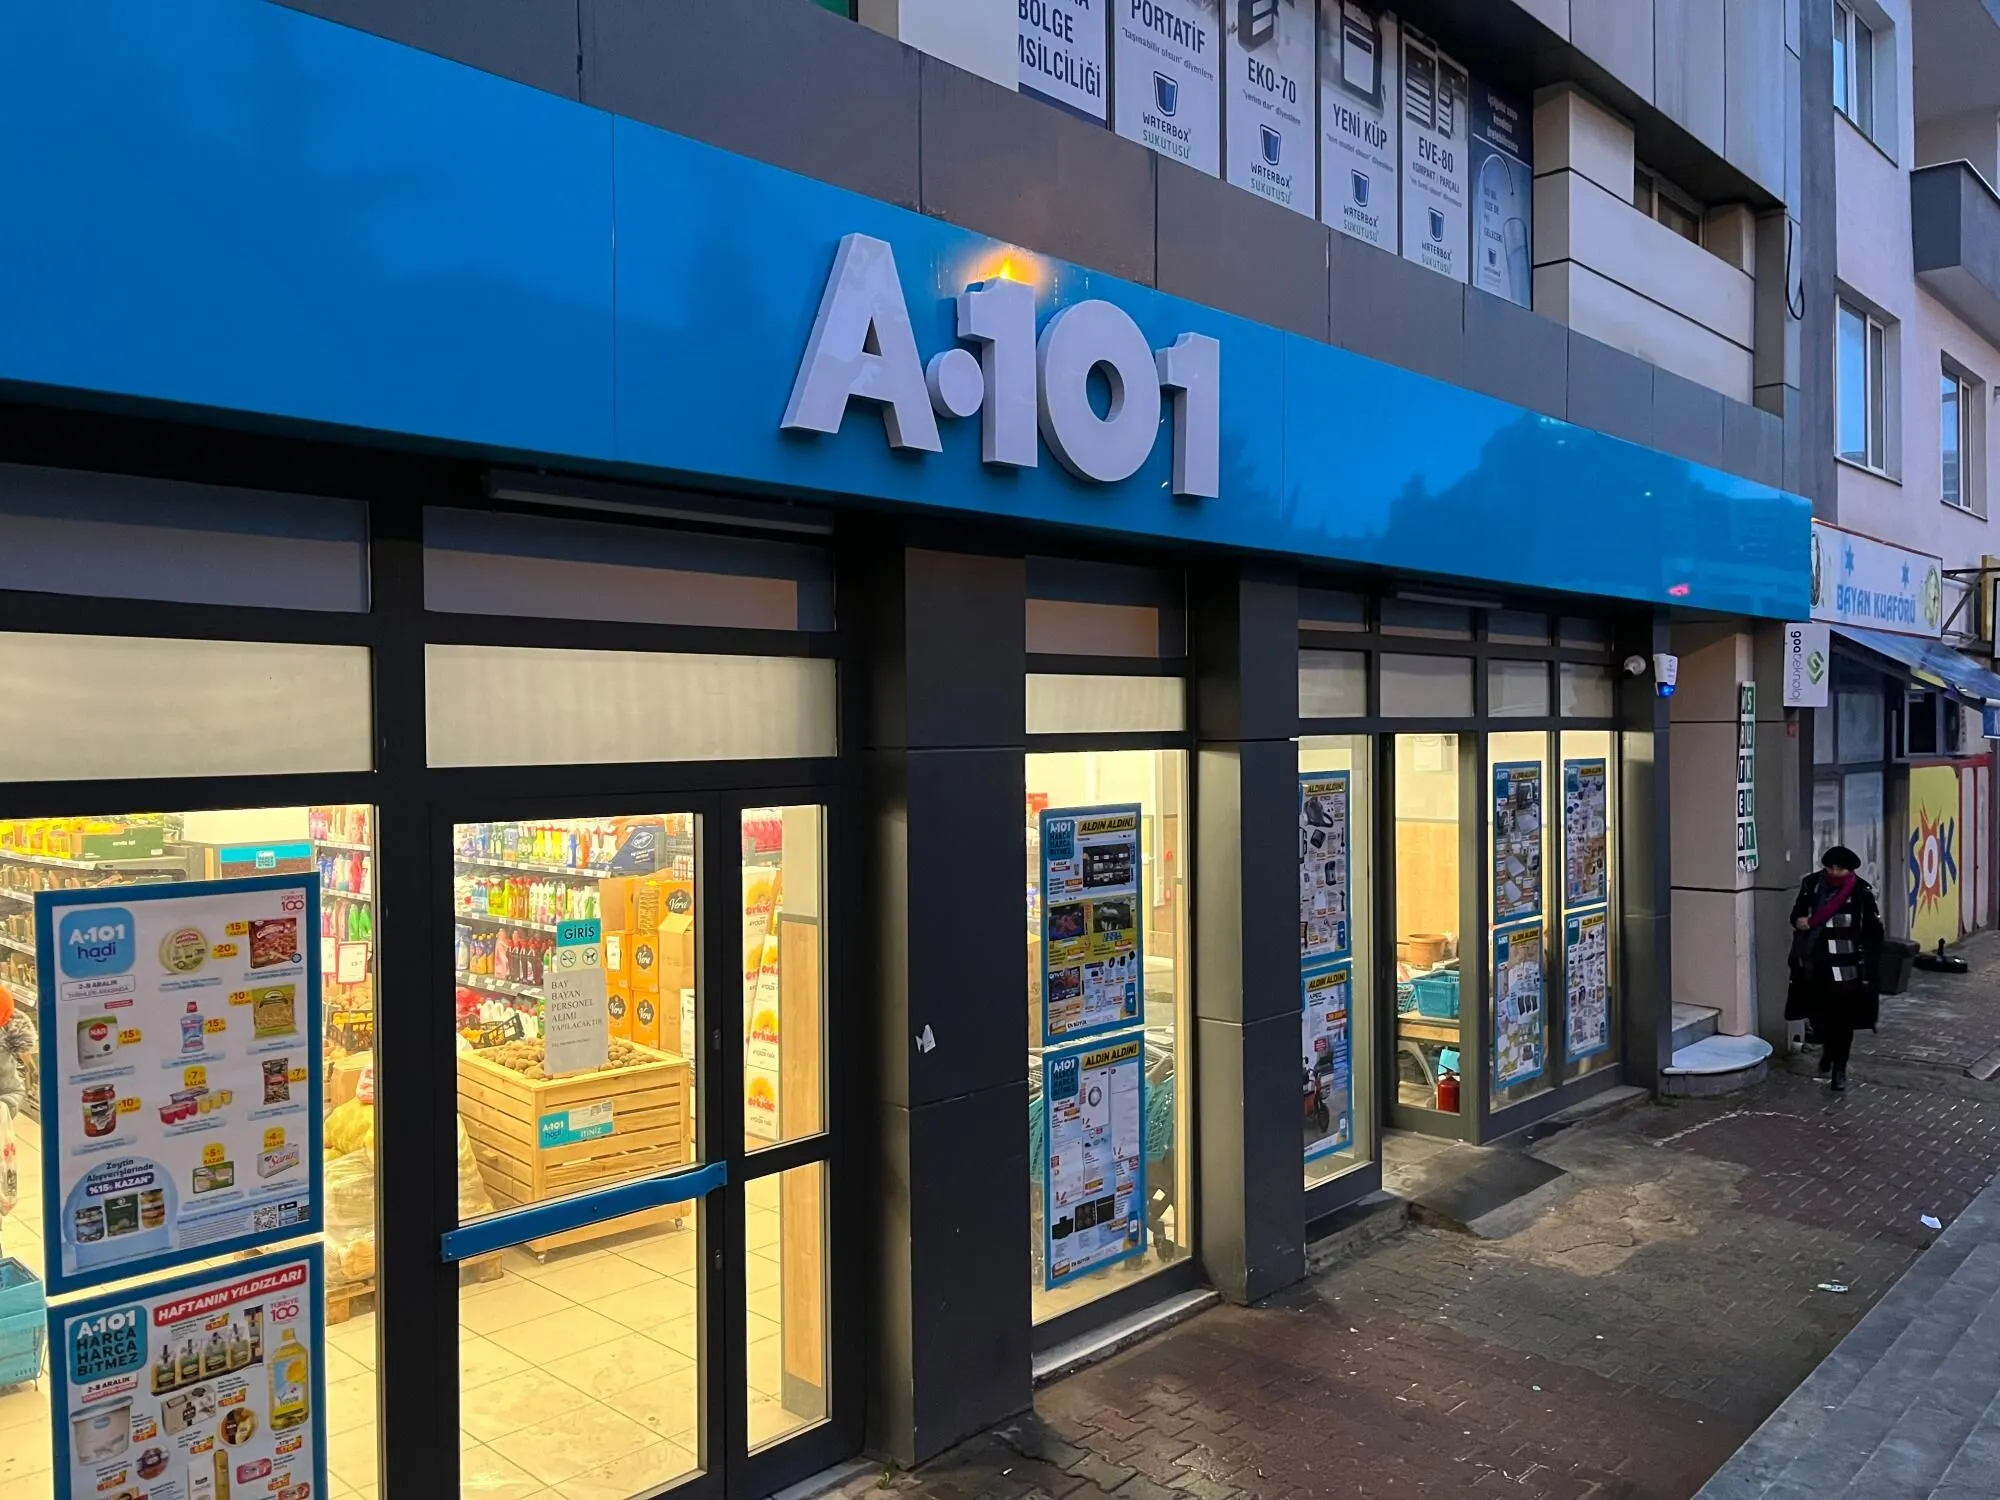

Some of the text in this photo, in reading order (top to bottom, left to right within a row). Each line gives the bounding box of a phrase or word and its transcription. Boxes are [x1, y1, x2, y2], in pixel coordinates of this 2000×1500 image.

[1131, 0, 1206, 53] PORTATİF
[1248, 57, 1296, 104] EKO-70
[1333, 104, 1387, 150] YENİ KÜP
[1419, 136, 1453, 173] EVE-80
[1837, 583, 1871, 616] BAYAN
[1081, 821, 1105, 832] ALDIN
[281, 900, 304, 912] 100
[564, 924, 595, 940] GİRİŞ
[77, 942, 116, 960] hadi
[552, 980, 569, 989] BAY
[552, 990, 581, 1000] BAYAN
[552, 999, 593, 1012] PERSONEL
[552, 1012, 577, 1022] ALIMI
[1085, 1052, 1110, 1066] ALDIN
[158, 1269, 302, 1320] HAFTANIN YILDIZLARI
[271, 1304, 299, 1321] 100
[77, 1327, 136, 1351] HARCA
[77, 1340, 137, 1365] HARCA
[78, 1352, 138, 1377] BİTMEZ
[102, 1376, 130, 1388] ARALIK
